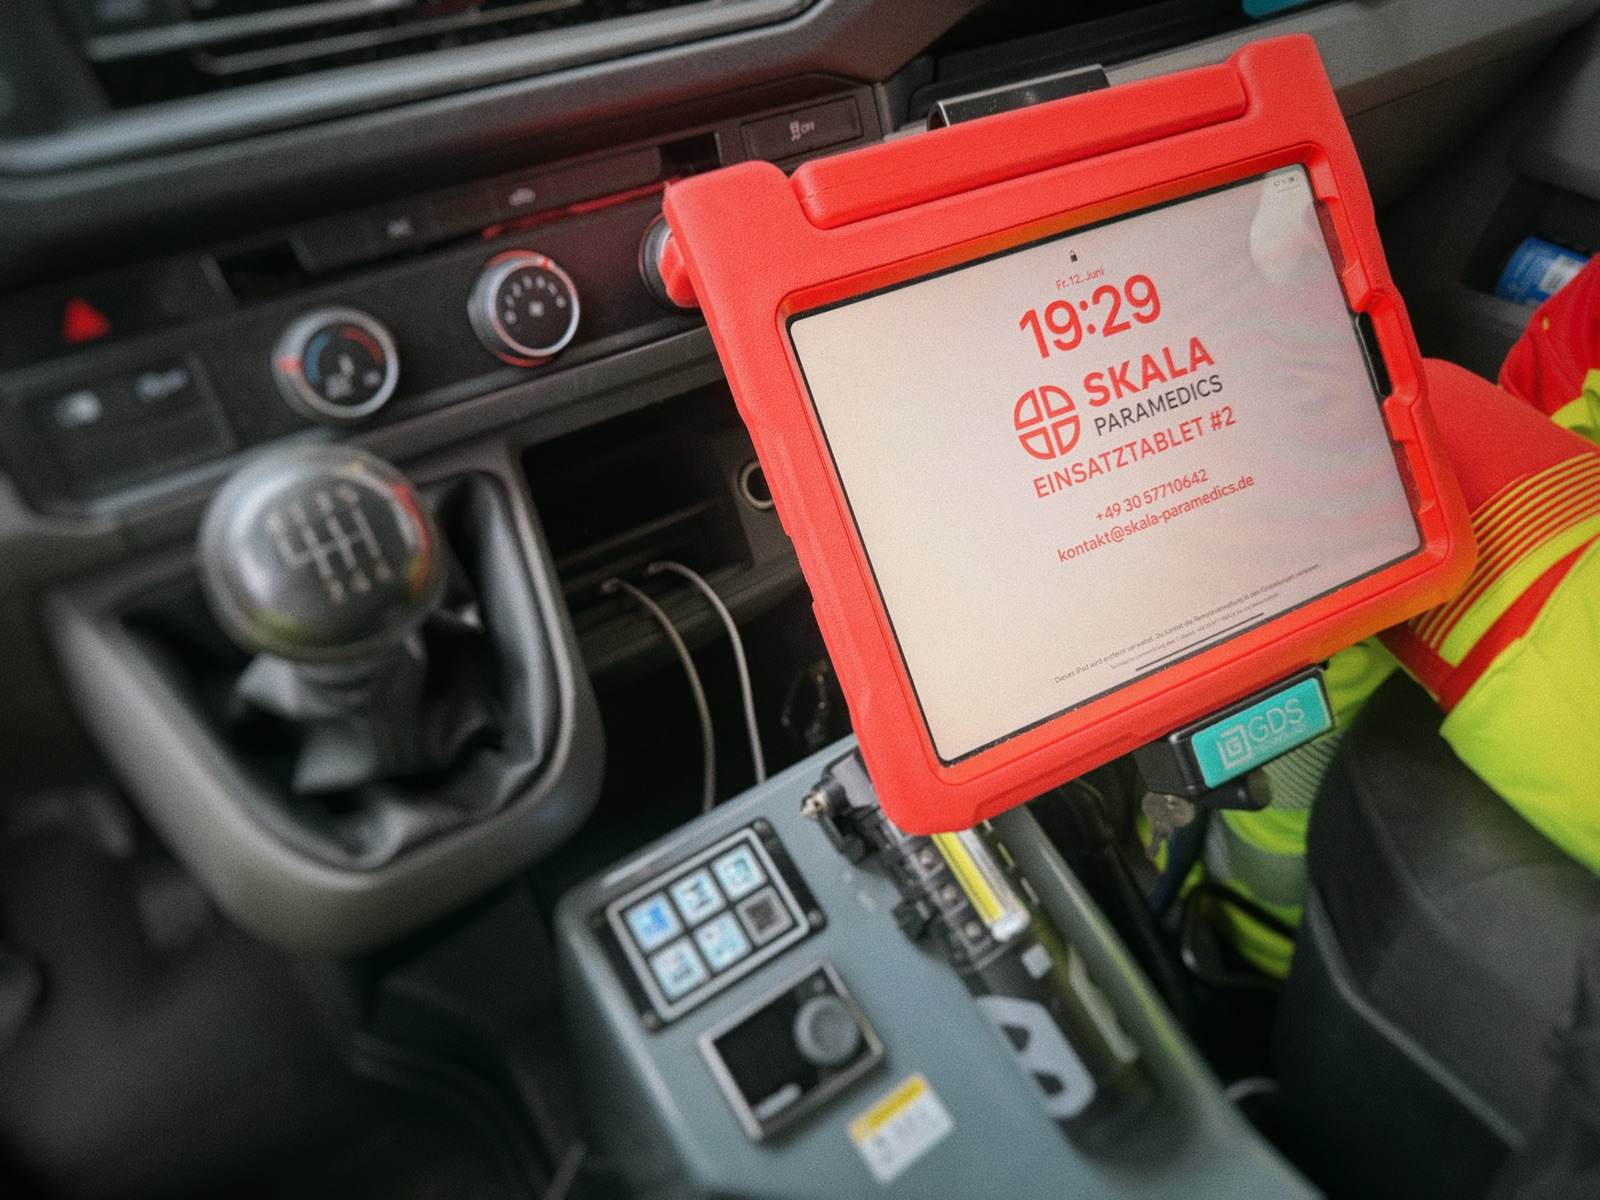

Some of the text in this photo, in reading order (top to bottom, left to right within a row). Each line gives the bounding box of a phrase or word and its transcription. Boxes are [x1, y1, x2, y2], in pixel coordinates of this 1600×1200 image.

[1055, 266, 1105, 290] Fr. 12. Juni
[1018, 273, 1161, 360] 19:29
[1083, 336, 1215, 408] SKALA
[1093, 374, 1223, 437] PARAMEDICS
[1033, 405, 1236, 499] EINSATZTABLET #2
[1057, 475, 1254, 562] kontakt@skala-paramedics.de
[1096, 468, 1208, 521] +49 30 57710642
[1055, 670, 1076, 683] Dieses
[1076, 663, 1089, 673] iPad
[1090, 658, 1103, 668] wird
[1103, 647, 1127, 662] entfernt
[1155, 631, 1164, 640] Du
[1165, 622, 1184, 634] kannst
[1248, 698, 1304, 742] GDS
